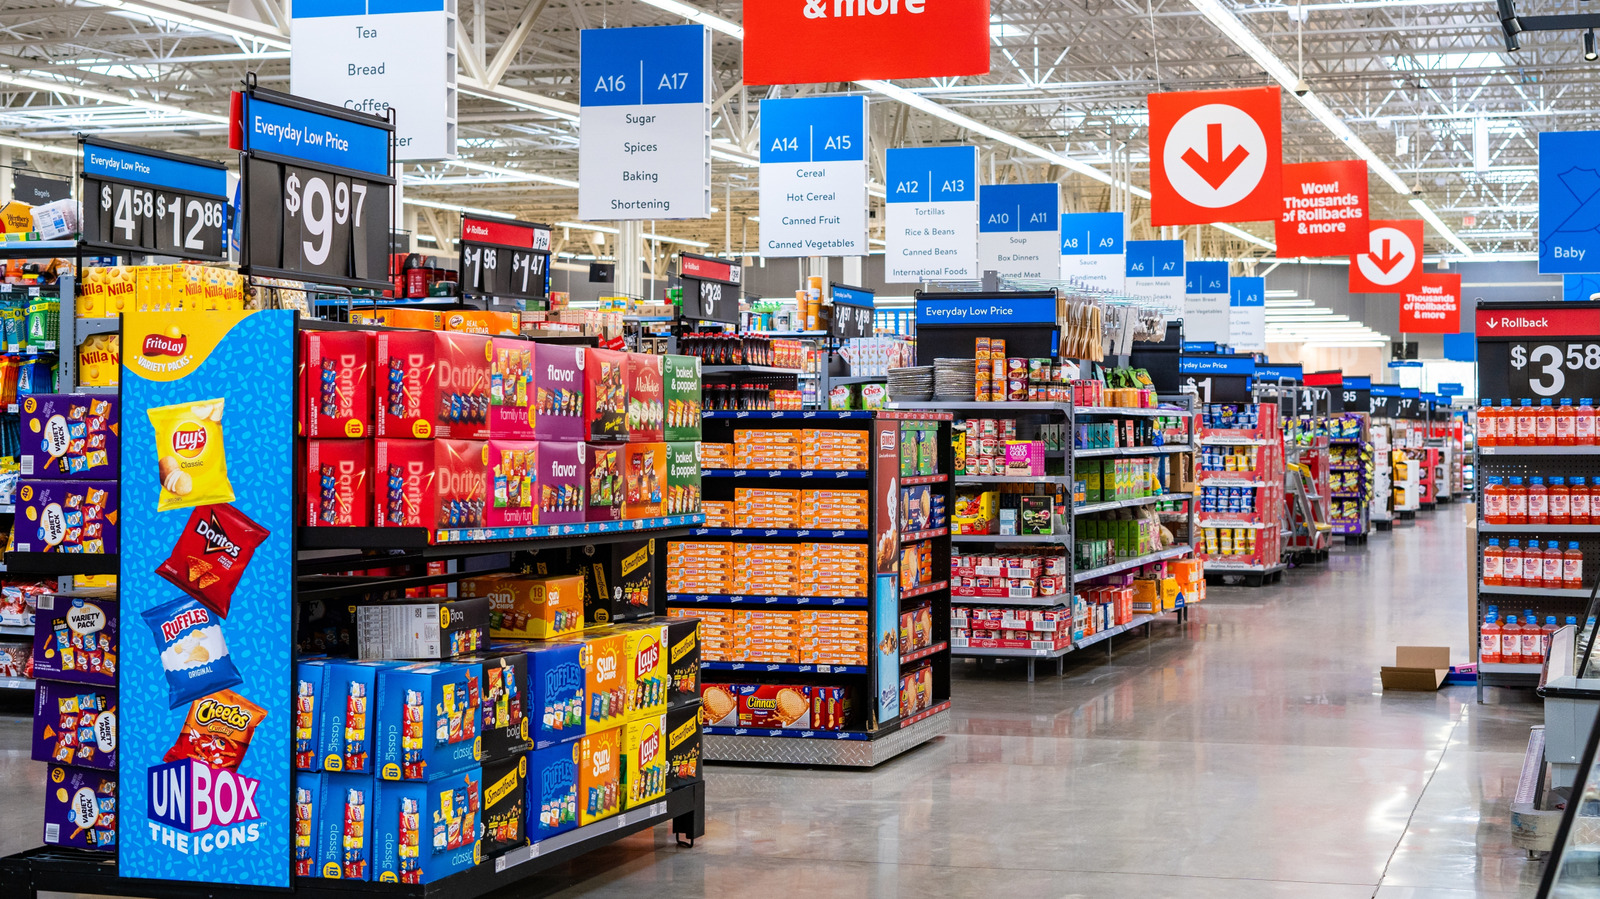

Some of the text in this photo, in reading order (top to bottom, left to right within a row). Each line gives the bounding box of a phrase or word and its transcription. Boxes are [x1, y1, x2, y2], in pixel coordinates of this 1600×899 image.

[803, 0, 925, 19] & more
[356, 26, 377, 38] Tea
[348, 62, 385, 76] Bread
[594, 72, 689, 93] A16 A17
[344, 99, 389, 112] Coffee
[625, 113, 656, 126] Sugar
[255, 115, 349, 151] Everyday Low Price
[624, 142, 658, 155] Spices
[770, 135, 852, 152] A14 A15
[90, 153, 151, 174] Everyday Low Price
[622, 171, 658, 183] Baking
[796, 169, 826, 178] Cereal
[34, 188, 50, 198] Bagels
[895, 179, 965, 194] A12 A13
[1301, 181, 1339, 195] Wow!
[786, 192, 836, 202] Hot Cereal
[1283, 193, 1359, 209] Thousands
[611, 198, 670, 211] Shortening
[914, 208, 946, 216] Tortillas
[987, 212, 1047, 224] A10 A11
[1297, 207, 1363, 221] Rollbacks
[781, 215, 841, 225] Canned Fruit
[471, 225, 488, 236] Rollback
[905, 228, 955, 236] Rice & Beans
[1297, 222, 1347, 235] & more
[768, 239, 855, 250] Canned Vegetables
[1009, 236, 1027, 245] Soup
[1063, 237, 1114, 249] A8 A9
[902, 248, 933, 256] Canned
[997, 254, 1039, 262] Box Dinners
[1554, 246, 1586, 261] Baby
[892, 267, 968, 277] International Foods
[1131, 262, 1175, 271] A6 A7
[107, 282, 134, 297] Nilla
[185, 284, 202, 296] Nilla
[1406, 293, 1455, 303] Thousands
[925, 306, 1014, 318] Everyday Low Price
[1403, 302, 1457, 312] of Rollbacks
[1413, 310, 1446, 319] & more
[1501, 317, 1549, 328] Rollback
[137, 356, 190, 372] VARIETY PACKS
[1199, 362, 1228, 370] Low Price
[438, 359, 491, 389] Doritos
[547, 364, 575, 382] flavor
[675, 365, 694, 379] baked
[341, 354, 356, 418] Doritos
[408, 354, 424, 419] Doritos
[671, 378, 698, 393] & popped
[863, 386, 882, 397] Chex
[25, 399, 33, 410] 40
[500, 407, 528, 424] family fun
[350, 423, 361, 434] 18
[418, 423, 429, 435] 18
[50, 421, 61, 452] VARIETY
[57, 426, 66, 446] PACK
[175, 428, 205, 451] Lay's
[180, 459, 204, 469] Classic
[675, 451, 693, 464] baked
[551, 460, 577, 478] flavor
[670, 463, 676, 476] &
[676, 463, 697, 478] popped
[22, 487, 30, 498] 40
[54, 514, 62, 534] PACK
[504, 509, 532, 525] family fun
[47, 509, 57, 541] VARIETY
[196, 519, 241, 557] Doritos
[622, 550, 648, 573] Smartfood
[593, 565, 607, 599] Smartfood
[489, 592, 515, 611] Sun
[71, 612, 101, 623] VARIETY
[77, 620, 96, 629] PACK
[160, 608, 209, 643] RUFFLES
[672, 636, 695, 660] Smartfood
[637, 645, 659, 676] Lay's
[188, 665, 213, 679] ORIGINAL
[596, 655, 617, 684] Sun CHIPS
[544, 661, 581, 700] RUFFLES
[747, 696, 777, 710] Cinnas
[197, 699, 250, 729] Cheetos
[207, 723, 234, 736] Crunchy
[331, 715, 341, 752] classic
[506, 725, 521, 738] bold
[388, 724, 398, 762] classic
[640, 732, 659, 767] Lay's
[541, 758, 574, 798] RUFFLES
[148, 821, 260, 855] THE ICONS
